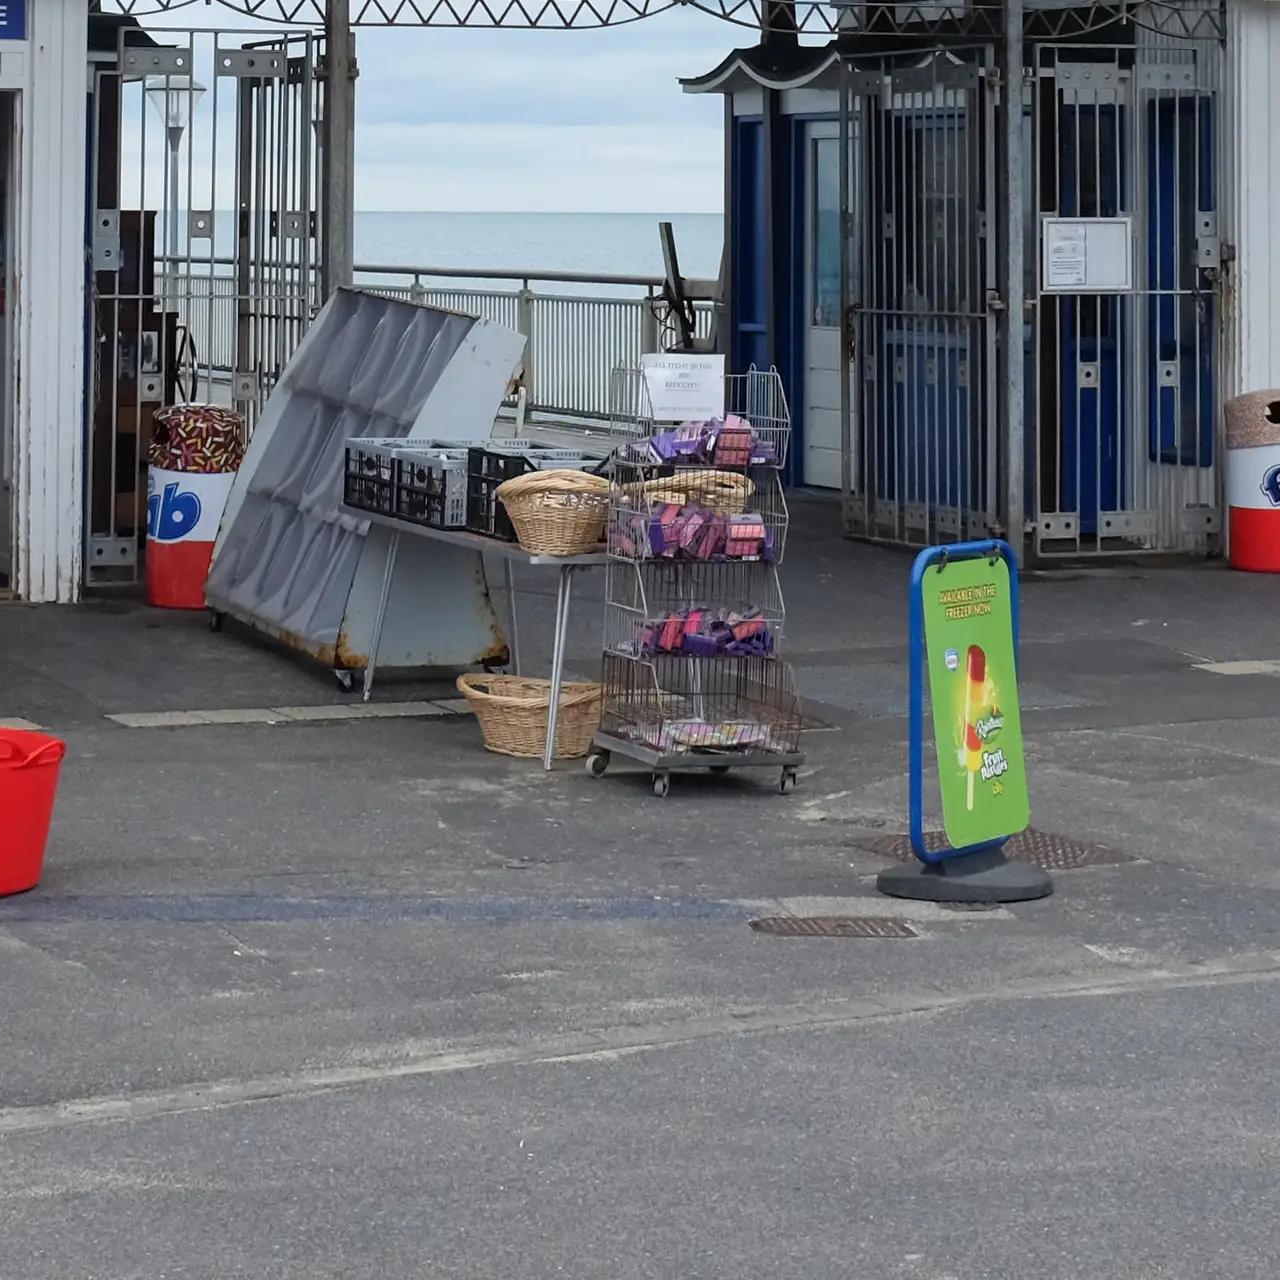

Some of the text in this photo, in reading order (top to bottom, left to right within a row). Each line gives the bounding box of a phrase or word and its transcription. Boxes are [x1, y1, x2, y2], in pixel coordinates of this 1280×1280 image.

[982, 583, 997, 597] THE
[945, 600, 992, 621] FREEZER NOW
